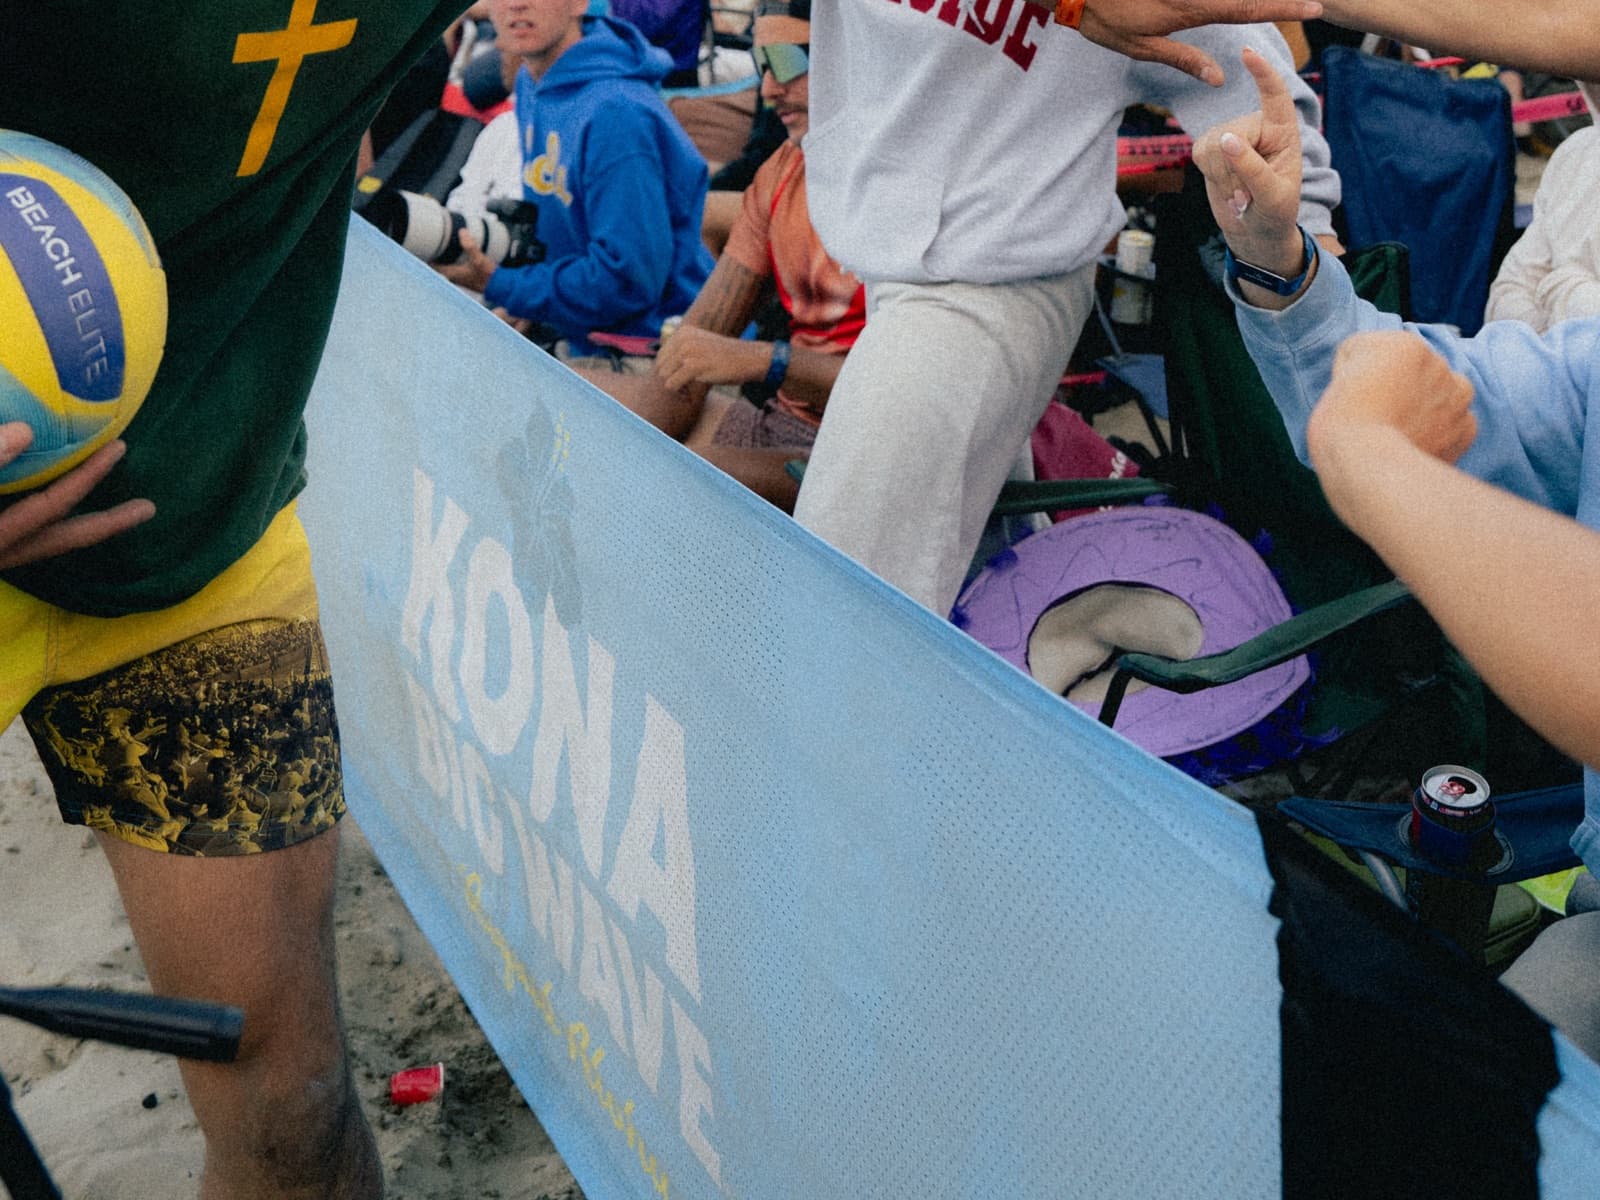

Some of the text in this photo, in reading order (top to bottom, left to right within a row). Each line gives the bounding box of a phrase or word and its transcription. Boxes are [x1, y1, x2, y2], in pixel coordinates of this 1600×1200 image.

[6, 186, 112, 384] BEACH ELITE
[401, 465, 703, 1006] KONA
[403, 667, 723, 1189] BIG WAVE
